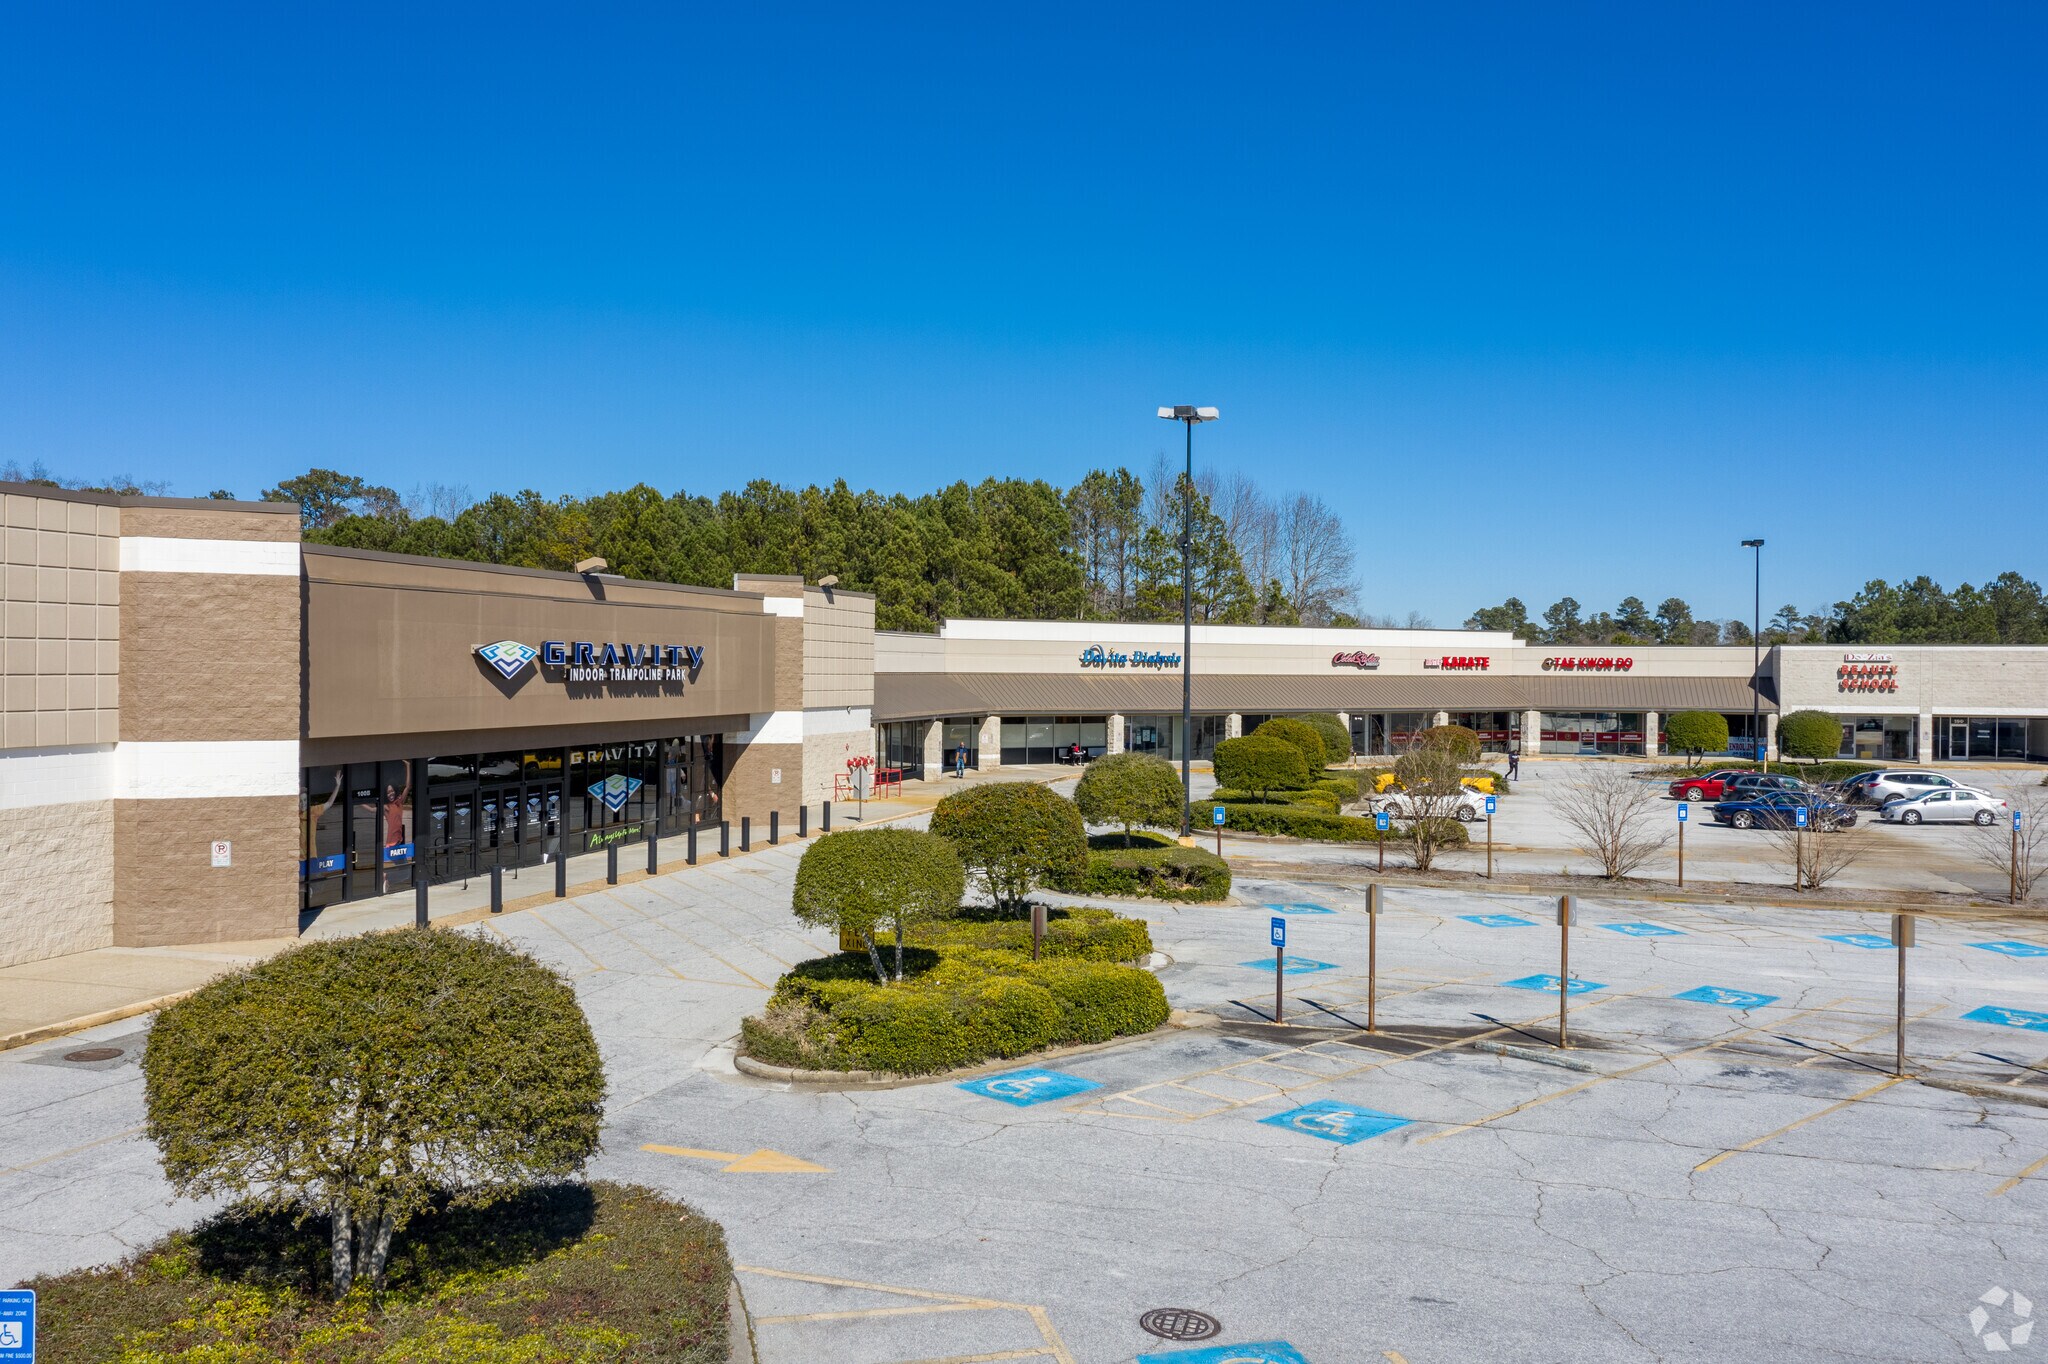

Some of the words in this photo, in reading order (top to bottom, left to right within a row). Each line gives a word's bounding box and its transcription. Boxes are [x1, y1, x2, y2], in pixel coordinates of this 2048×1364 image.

[543, 640, 705, 669] GRAVITY
[1082, 644, 1127, 667] DaVita
[1132, 650, 1181, 667] Dialysis
[1442, 656, 1489, 668] KARATE
[1554, 657, 1575, 668] TAE
[1578, 657, 1614, 668] KWON
[1615, 657, 1633, 669] DO
[570, 668, 604, 681] INDOOR
[610, 668, 662, 681] TRAMPOLINE
[666, 668, 686, 681] PARK
[1841, 664, 1898, 675] BEAUTY
[1842, 678, 1899, 689] SCHOOL
[570, 742, 656, 764] GRAVITY
[390, 848, 407, 856] PARTY
[318, 859, 334, 869] PLAY
